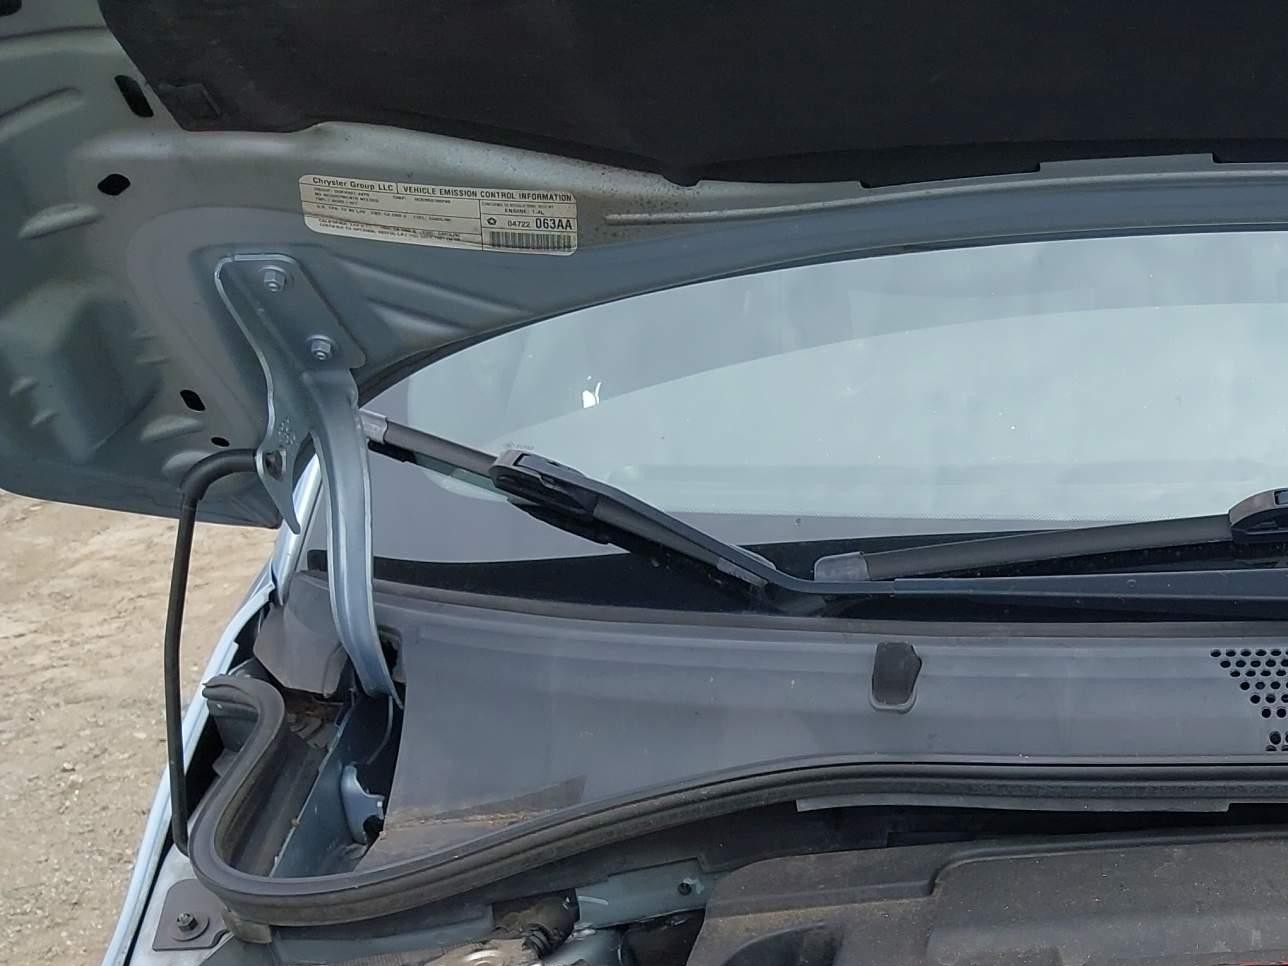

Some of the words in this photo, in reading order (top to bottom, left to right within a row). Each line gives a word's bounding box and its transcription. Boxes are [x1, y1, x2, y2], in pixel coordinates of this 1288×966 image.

[312, 176, 347, 188] Chrysler
[350, 180, 375, 191] Group
[378, 184, 393, 192] LLC
[403, 186, 436, 195] VEHICLE
[440, 189, 477, 198] EMISSION
[480, 190, 516, 200] CONTROL
[519, 192, 572, 202] INFORMATION
[507, 220, 531, 228] 04722
[535, 217, 573, 230] 063AA
